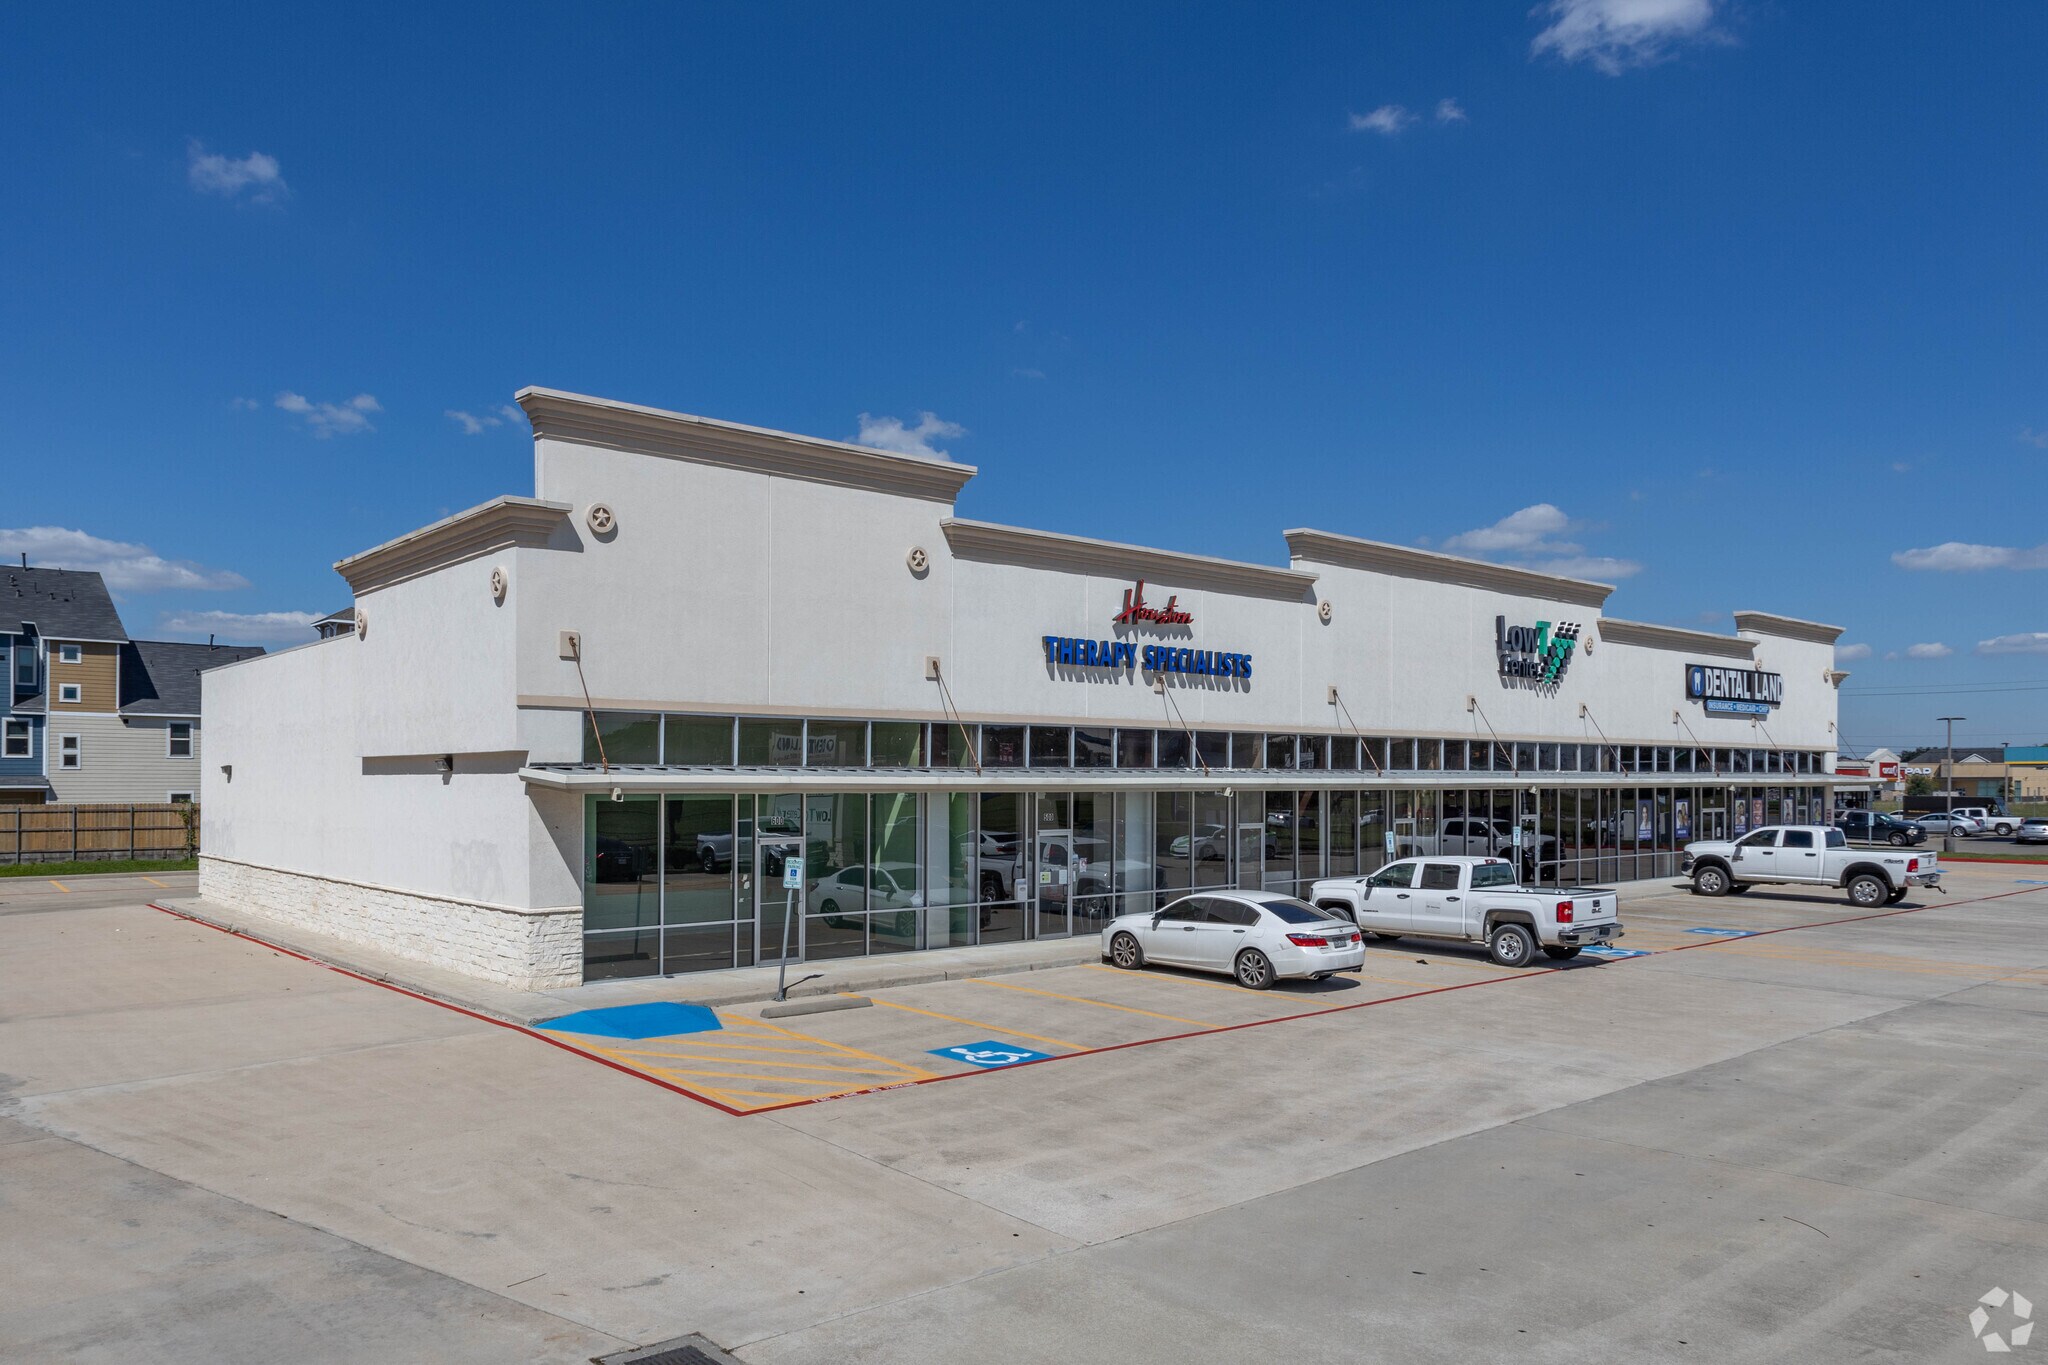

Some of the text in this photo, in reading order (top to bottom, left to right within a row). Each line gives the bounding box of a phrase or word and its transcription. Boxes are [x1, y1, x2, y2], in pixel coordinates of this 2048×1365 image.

[1112, 579, 1194, 625] Houston
[1043, 636, 1252, 679] THERAPY SPECIALISTS
[1500, 654, 1541, 679] Center
[1705, 668, 1784, 702] DENTAL LAND
